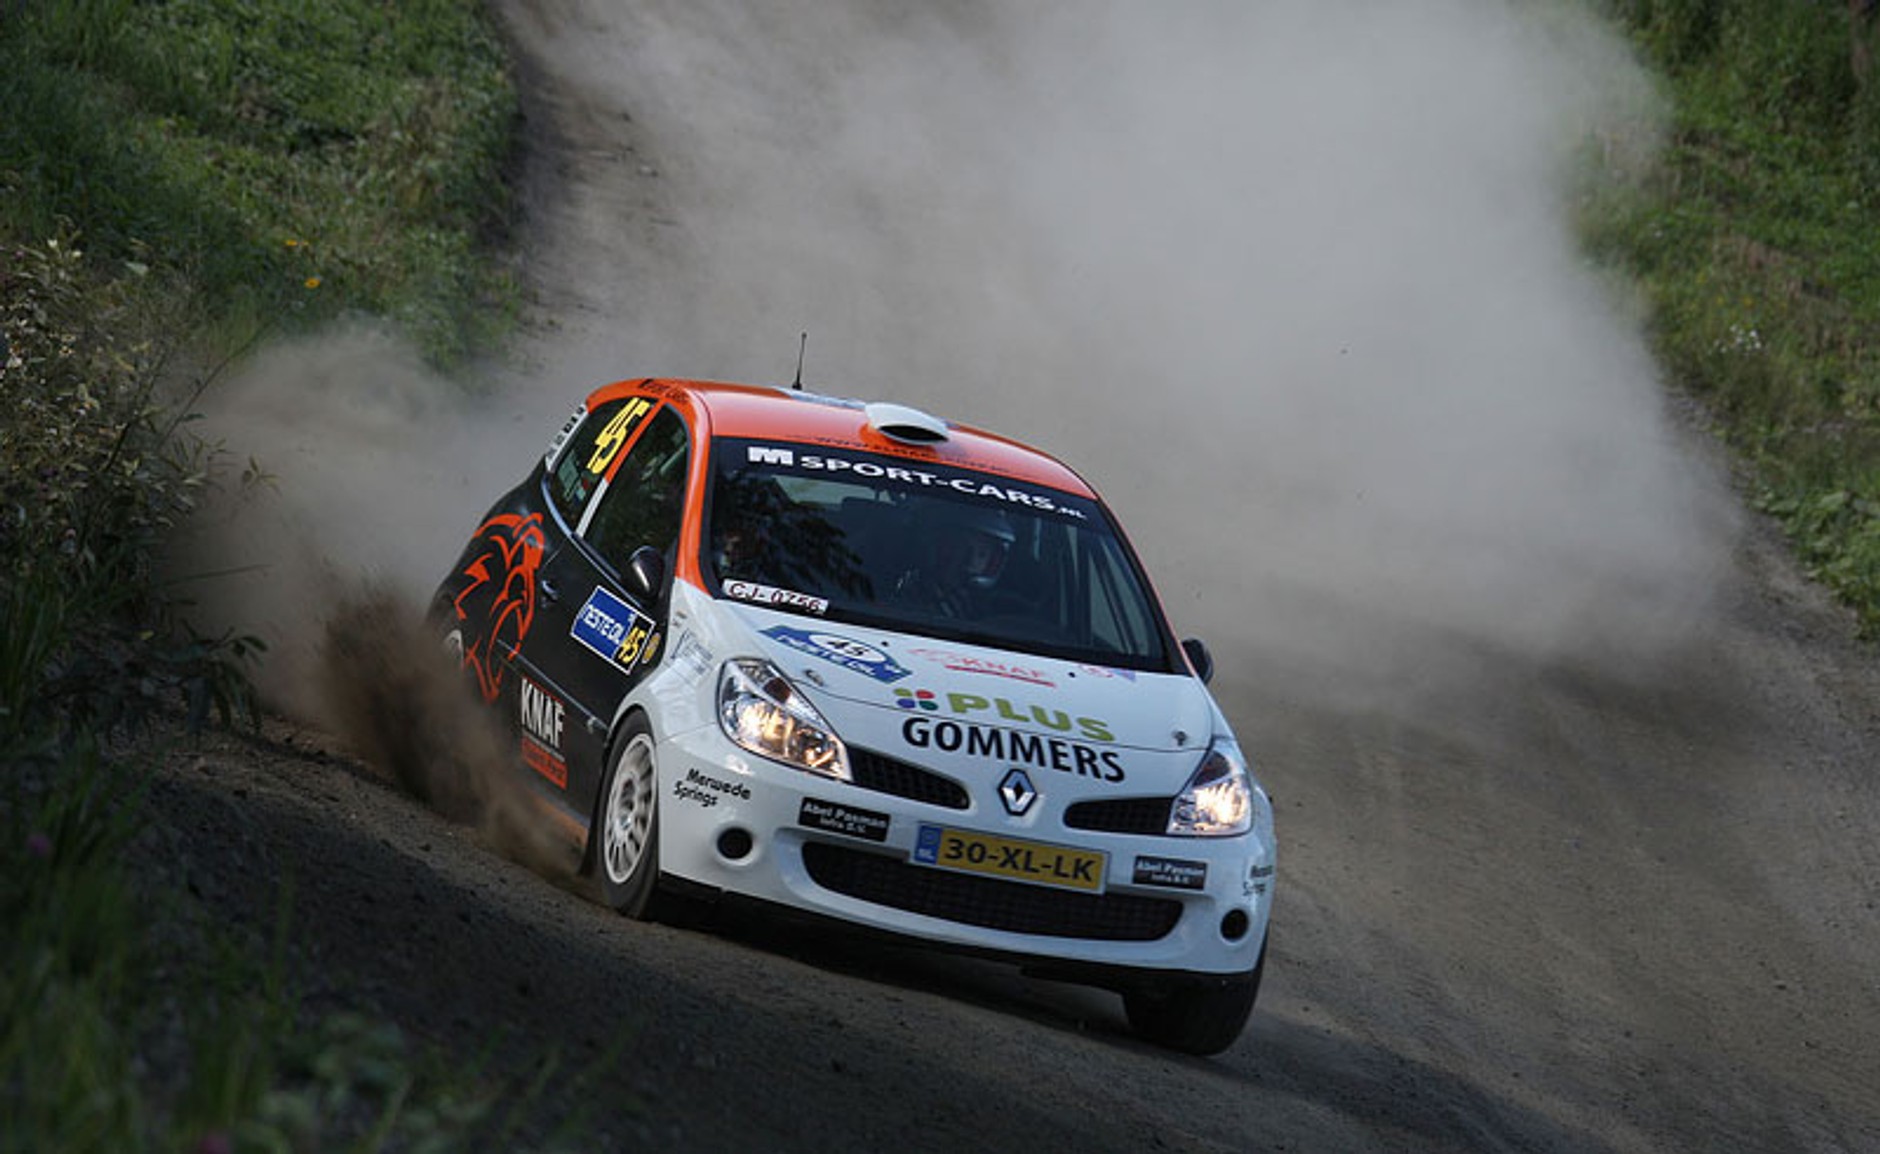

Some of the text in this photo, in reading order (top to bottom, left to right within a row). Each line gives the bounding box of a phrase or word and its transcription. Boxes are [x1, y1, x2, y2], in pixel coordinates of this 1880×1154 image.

[587, 397, 650, 474] 45
[748, 446, 794, 466] M
[618, 626, 646, 664] 45
[826, 641, 869, 657] 45
[521, 677, 566, 749] KNAF
[946, 692, 1115, 742] PLUS
[902, 717, 1125, 783] GOMMERS
[674, 780, 718, 807] Springs
[686, 767, 752, 800] Merwede
[803, 802, 833, 818] Abel
[944, 838, 1097, 882] 30-XL-LK
